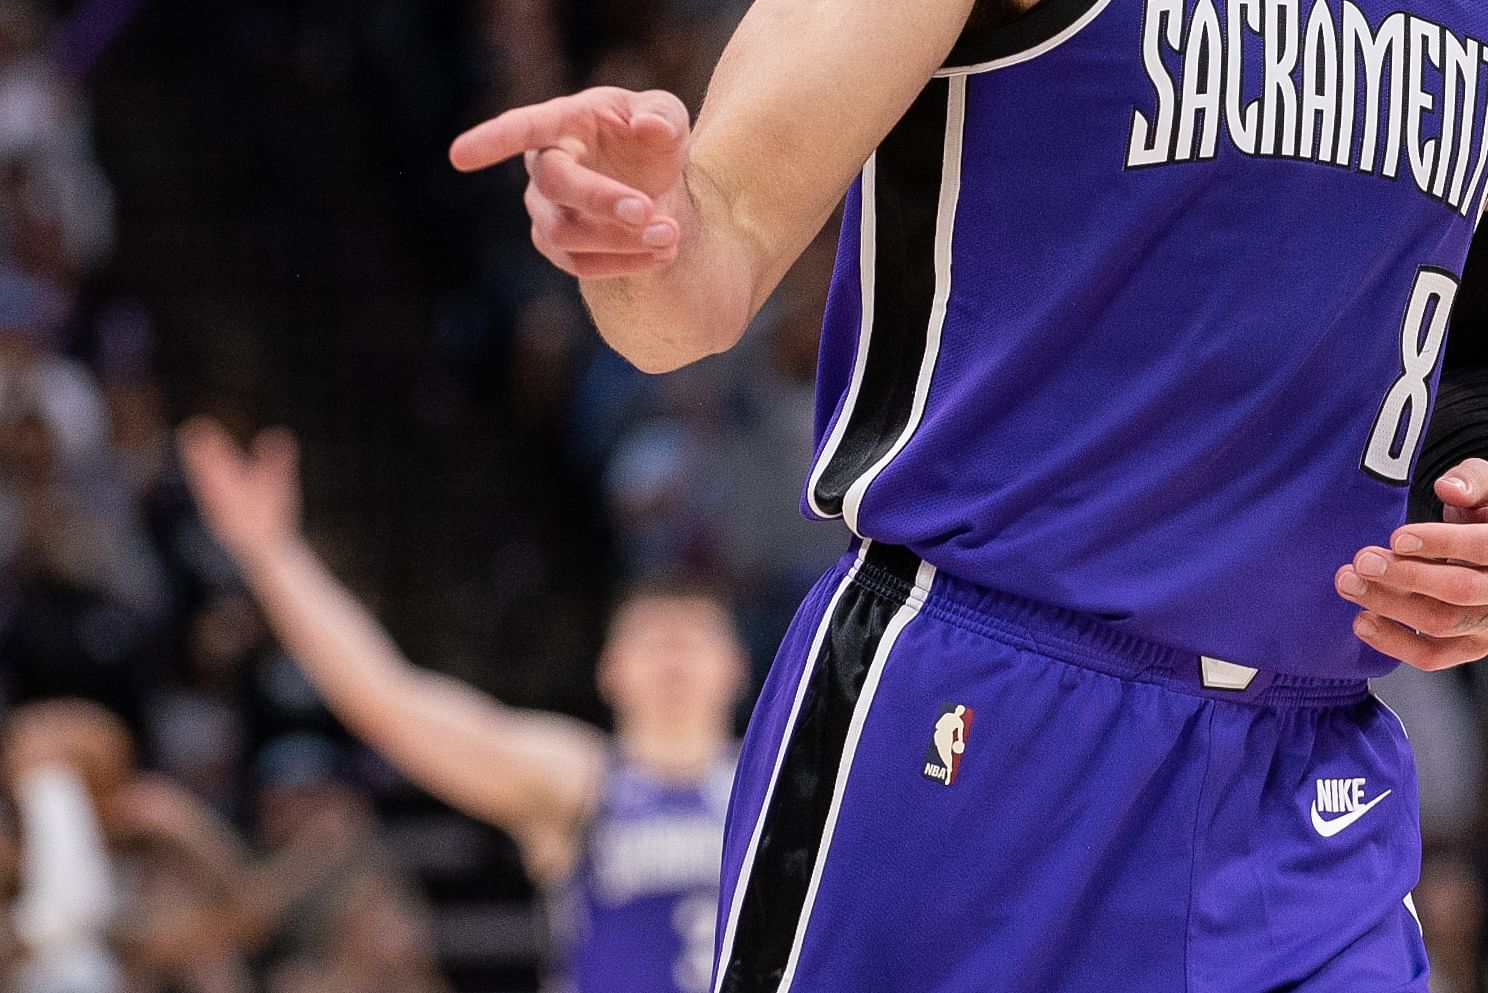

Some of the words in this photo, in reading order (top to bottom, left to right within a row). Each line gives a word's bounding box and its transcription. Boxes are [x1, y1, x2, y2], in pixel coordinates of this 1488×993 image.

[1360, 265, 1461, 486] 8
[923, 762, 947, 780] NBA
[1316, 777, 1366, 812] NIKE
